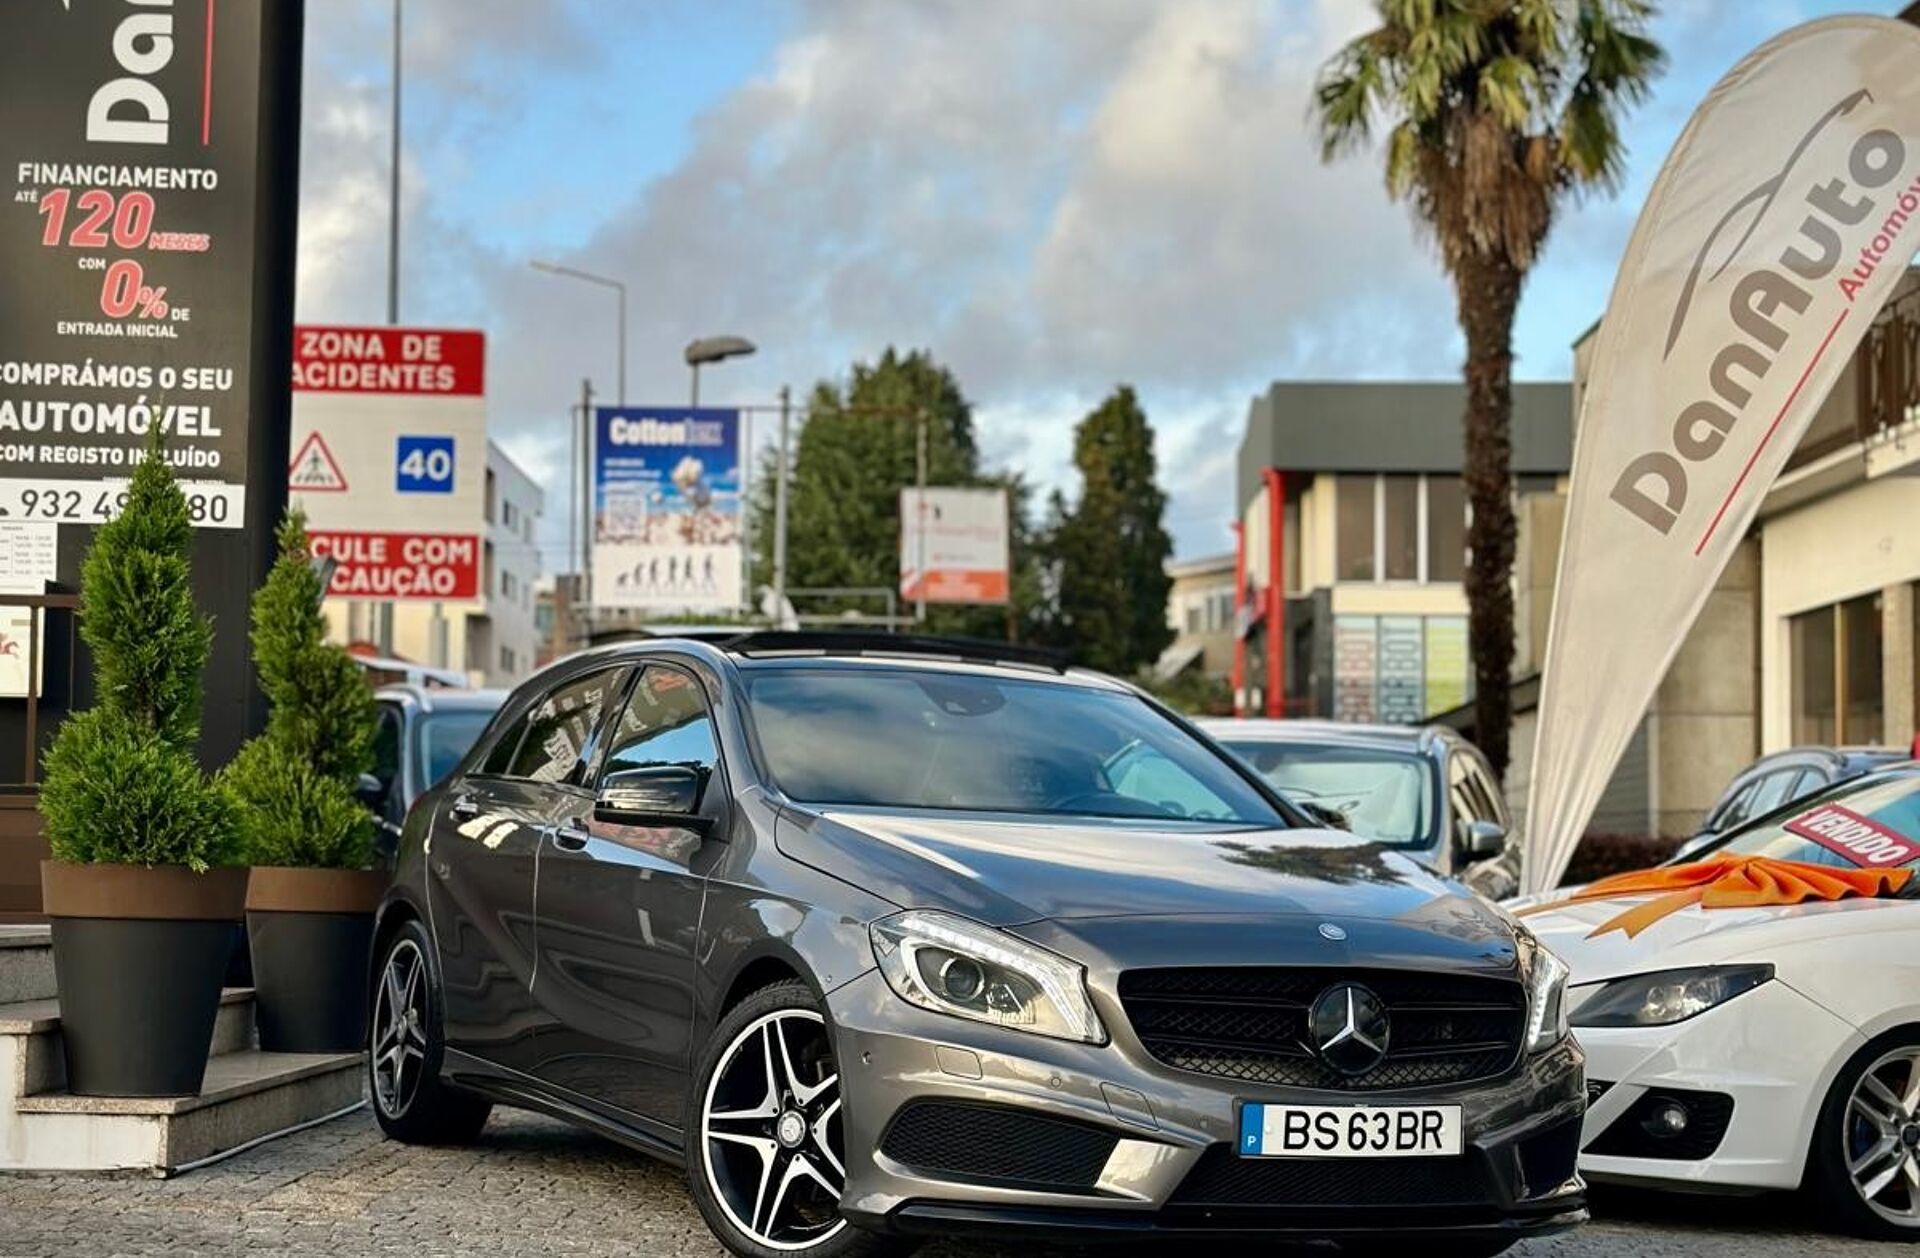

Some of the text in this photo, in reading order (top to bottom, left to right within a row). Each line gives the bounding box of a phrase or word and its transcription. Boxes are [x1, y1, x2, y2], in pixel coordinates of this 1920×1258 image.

[86, 0, 174, 145] Da
[18, 163, 218, 190] FINANCIAMENTO
[15, 188, 211, 251] ATÉ 120 MESES
[78, 257, 190, 321] COM 0% DE
[57, 321, 178, 338] ENTRADA INICIAL
[1609, 128, 1906, 537] DanAuto
[301, 332, 442, 361] ZONA DE
[0, 357, 233, 390] OMPRÁMOS O SEU
[292, 361, 455, 391] ACIDENTES
[0, 394, 222, 437] AUTOMÓVEL
[39, 445, 124, 465] REGISTO
[128, 444, 220, 468] INLUÍDO
[400, 448, 450, 481] 40
[21, 489, 82, 519] 932
[402, 538, 473, 565] COM
[1800, 809, 1911, 863] VENDIDO
[1246, 1135, 1257, 1147] P
[1283, 1110, 1444, 1150] BS 63 BR
